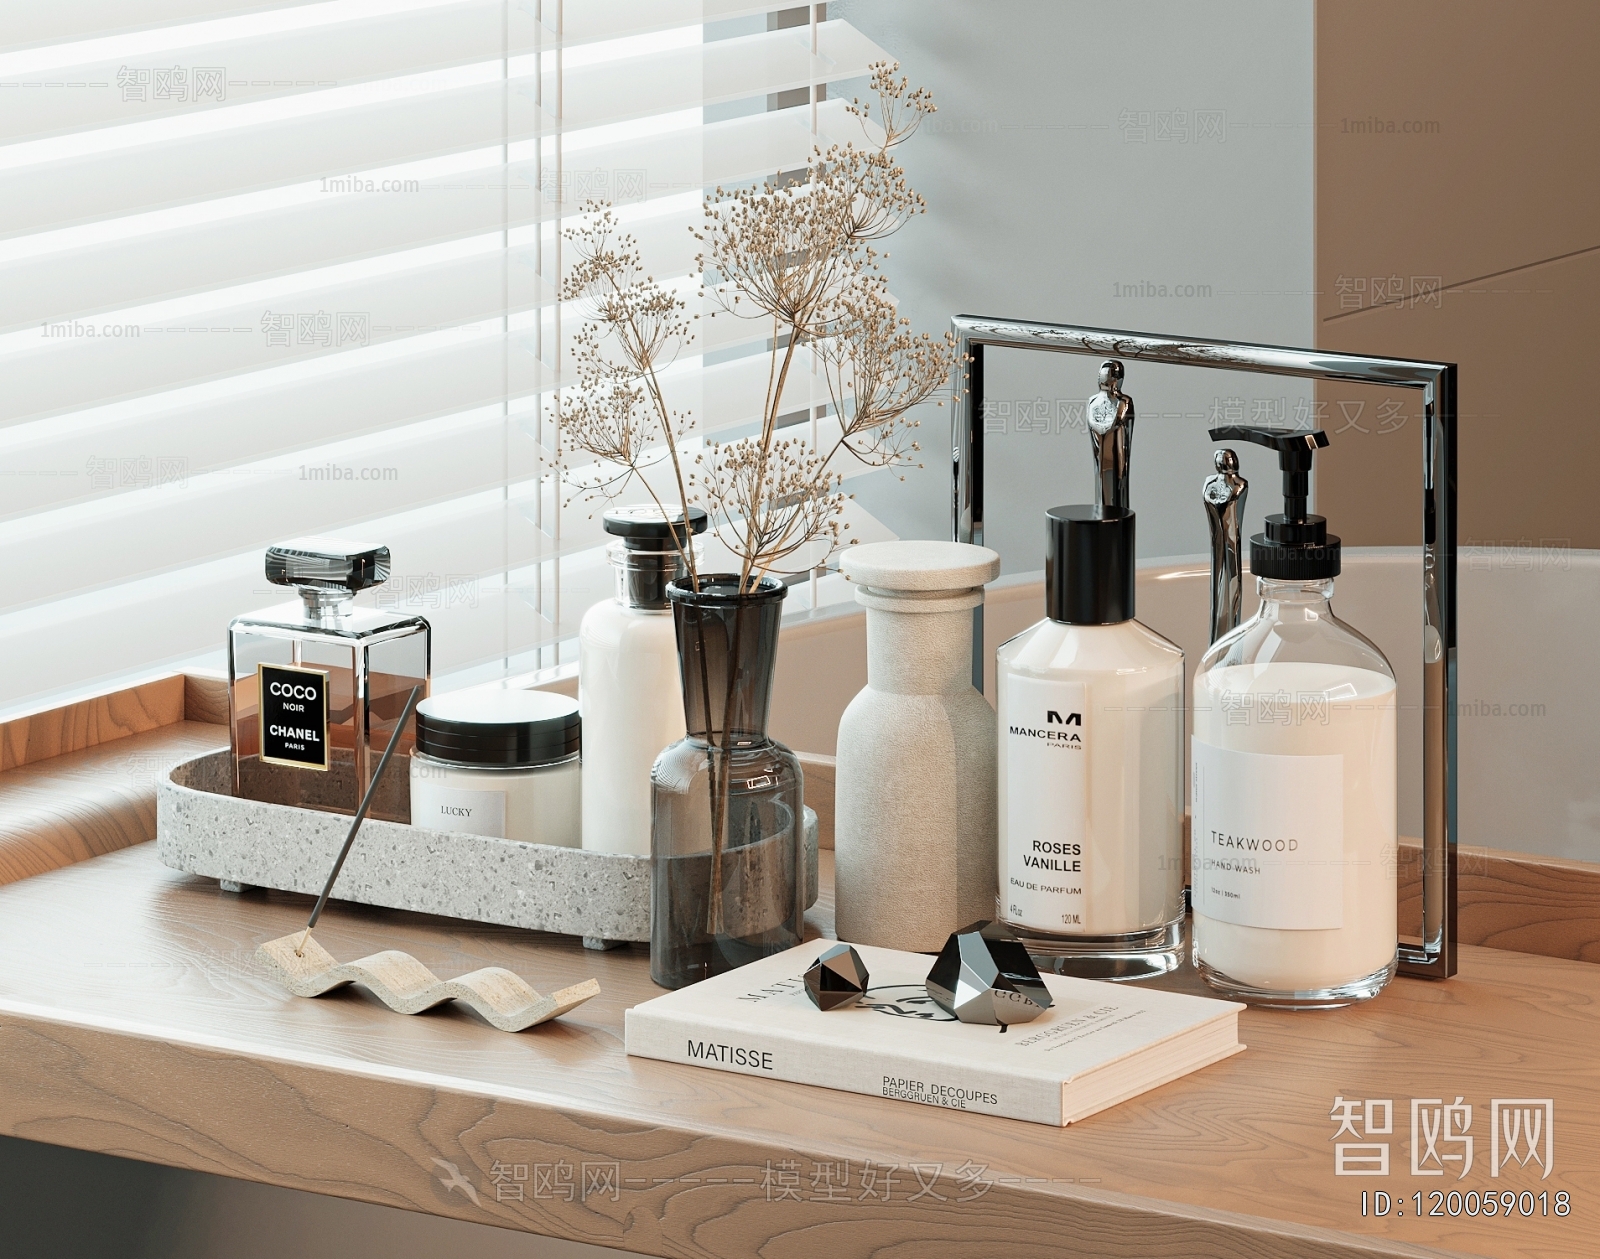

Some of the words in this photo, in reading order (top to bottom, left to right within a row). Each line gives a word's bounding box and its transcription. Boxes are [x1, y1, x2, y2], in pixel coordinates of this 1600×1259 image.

[270, 681, 317, 701] COCO
[282, 702, 305, 712] NOIR
[269, 724, 320, 742] CHANEL
[1009, 725, 1082, 743] MANCERA
[284, 742, 305, 751] PARIS
[1046, 742, 1082, 751] PARIS
[440, 805, 473, 817] LUCKY
[1032, 839, 1081, 856] ROSES
[1210, 830, 1299, 852] TEAKWOOD
[1022, 854, 1082, 872] VANILLE
[1211, 859, 1232, 871] HAND
[1234, 864, 1261, 875] WASH
[1010, 877, 1025, 888] EAU
[1026, 882, 1038, 891] DE
[1040, 885, 1082, 895] PARFUM
[1061, 913, 1072, 924] 120
[1072, 914, 1082, 924] ML
[687, 1039, 774, 1070] MATISSE
[882, 1075, 925, 1093] PAPIER
[930, 1083, 998, 1105] DECOUPES
[882, 1086, 940, 1105] BERGGRUEN
[941, 1096, 949, 1106] &
[951, 1098, 966, 1109] CIE
